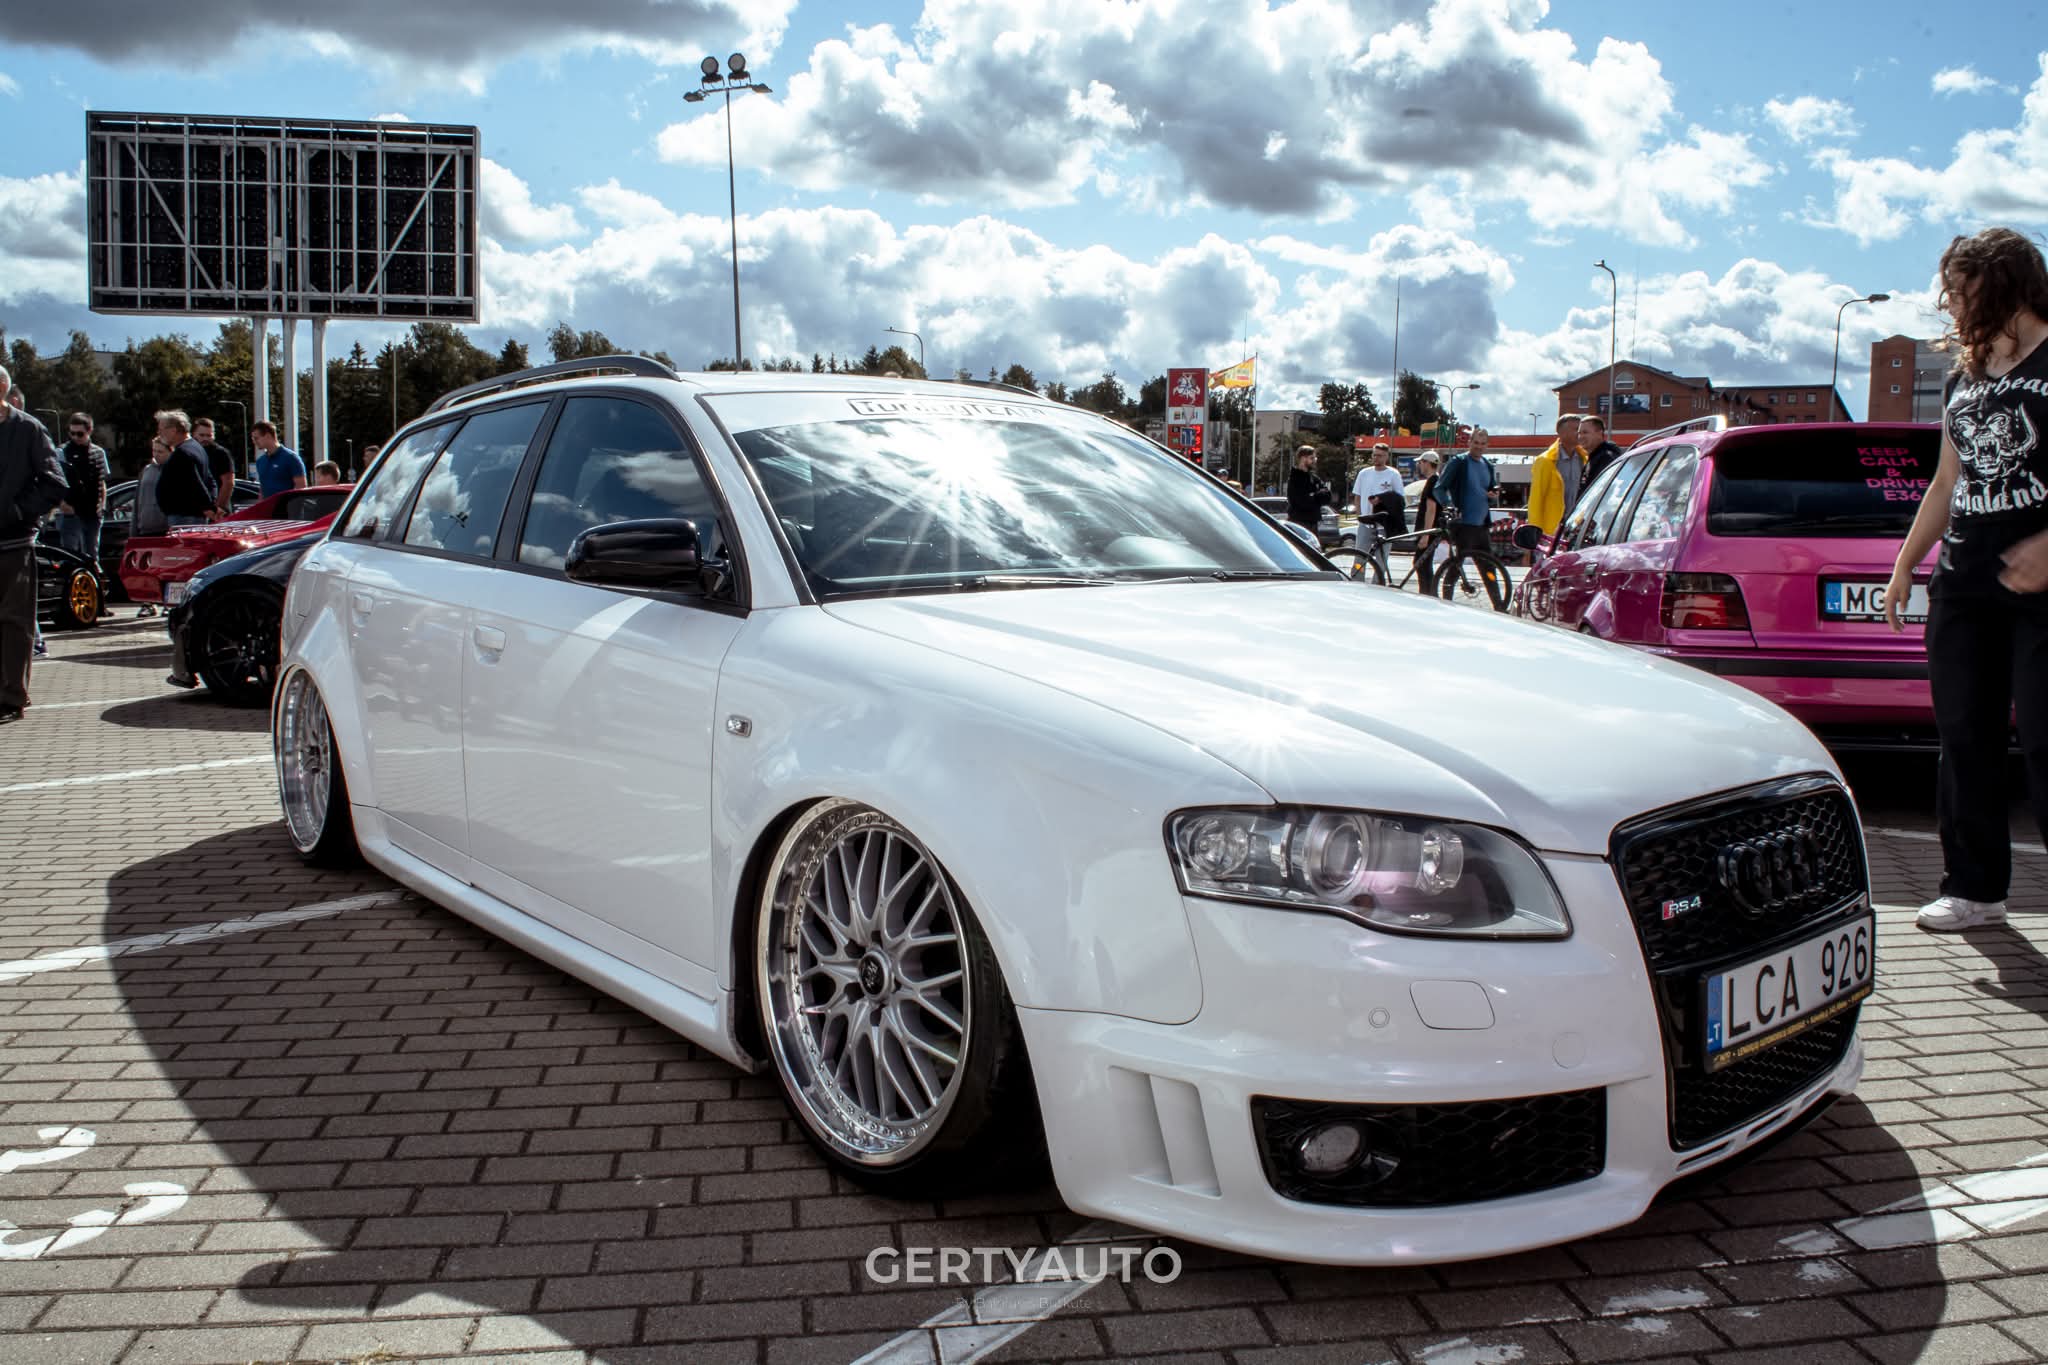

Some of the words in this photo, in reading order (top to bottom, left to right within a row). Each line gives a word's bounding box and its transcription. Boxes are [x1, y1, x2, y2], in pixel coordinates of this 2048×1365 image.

[1857, 447, 1910, 457] KEEP
[1859, 457, 1919, 467] CALM
[1886, 468, 1902, 477] &
[1866, 478, 1930, 489] DRIVE
[1883, 490, 1923, 501] E36
[1826, 602, 1840, 610] LT
[1727, 955, 1800, 1039] LCA
[1820, 926, 1868, 997] 926
